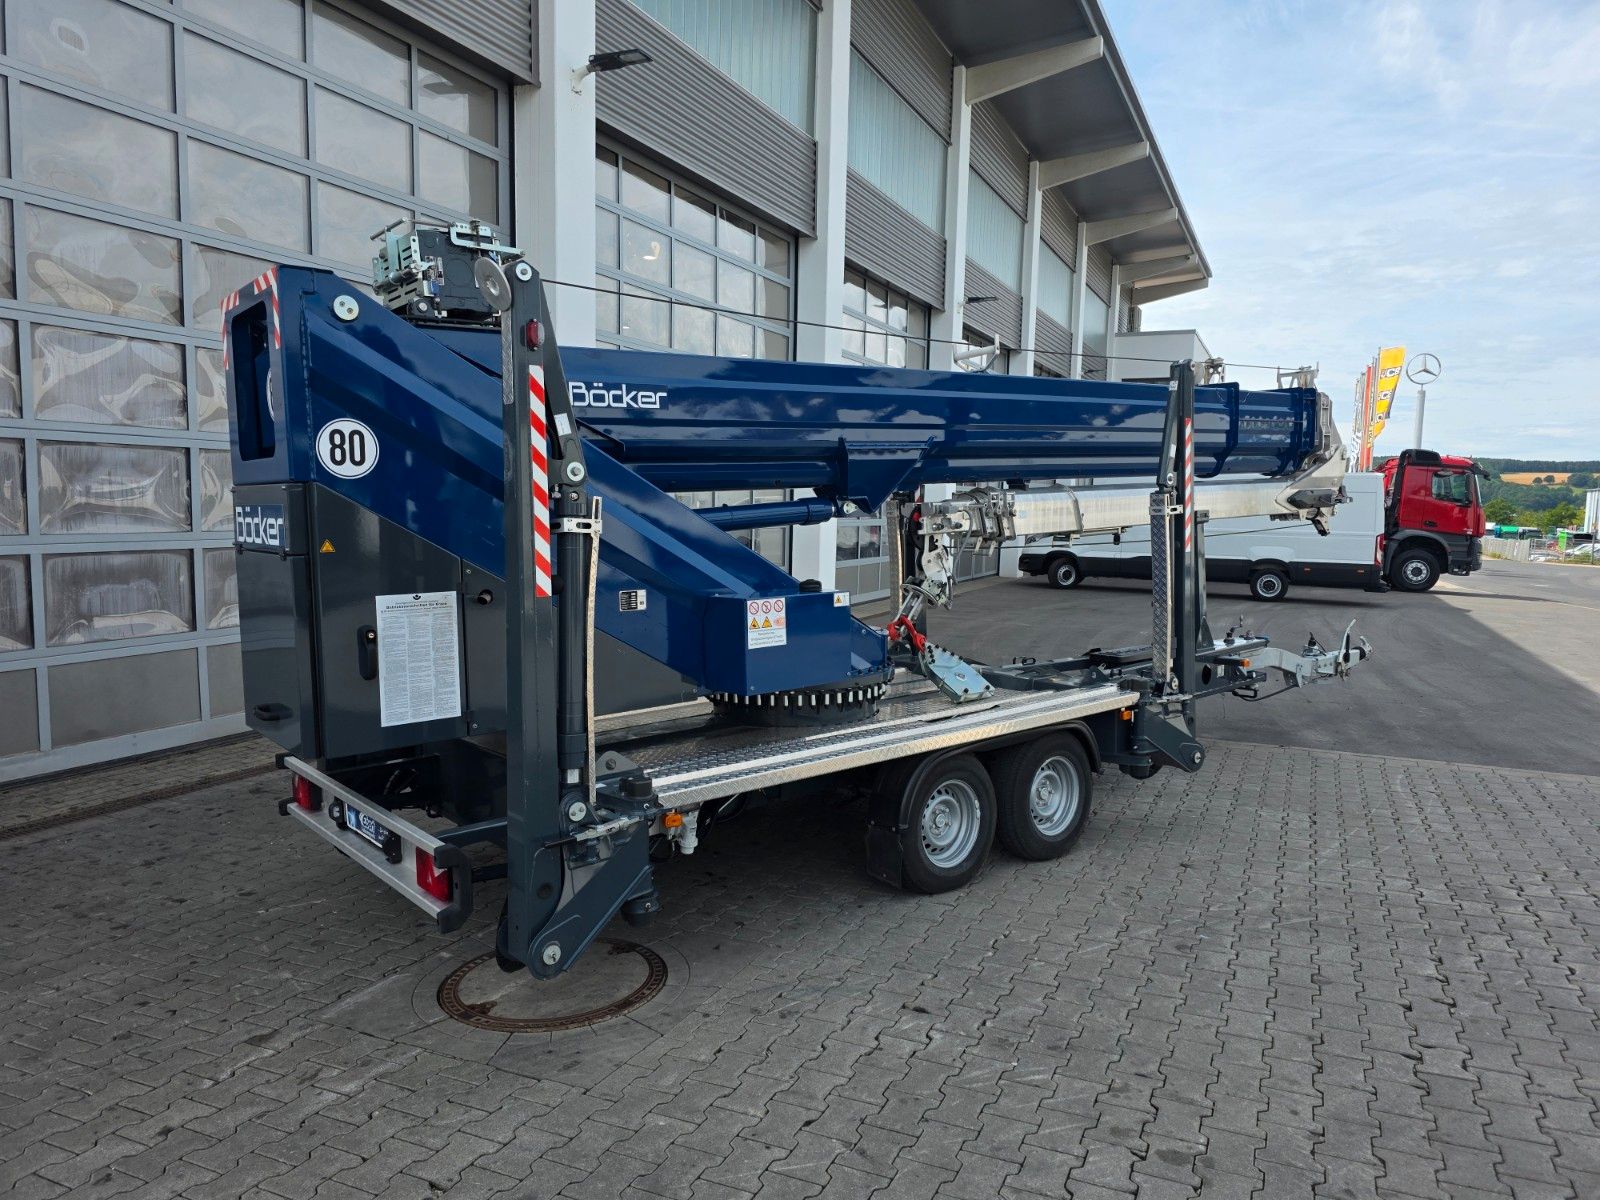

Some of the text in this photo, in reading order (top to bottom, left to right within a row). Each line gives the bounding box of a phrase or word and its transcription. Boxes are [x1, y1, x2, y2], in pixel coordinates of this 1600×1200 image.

[568, 381, 667, 409] Böcker
[329, 428, 366, 466] 80
[235, 506, 284, 546] Böcker
